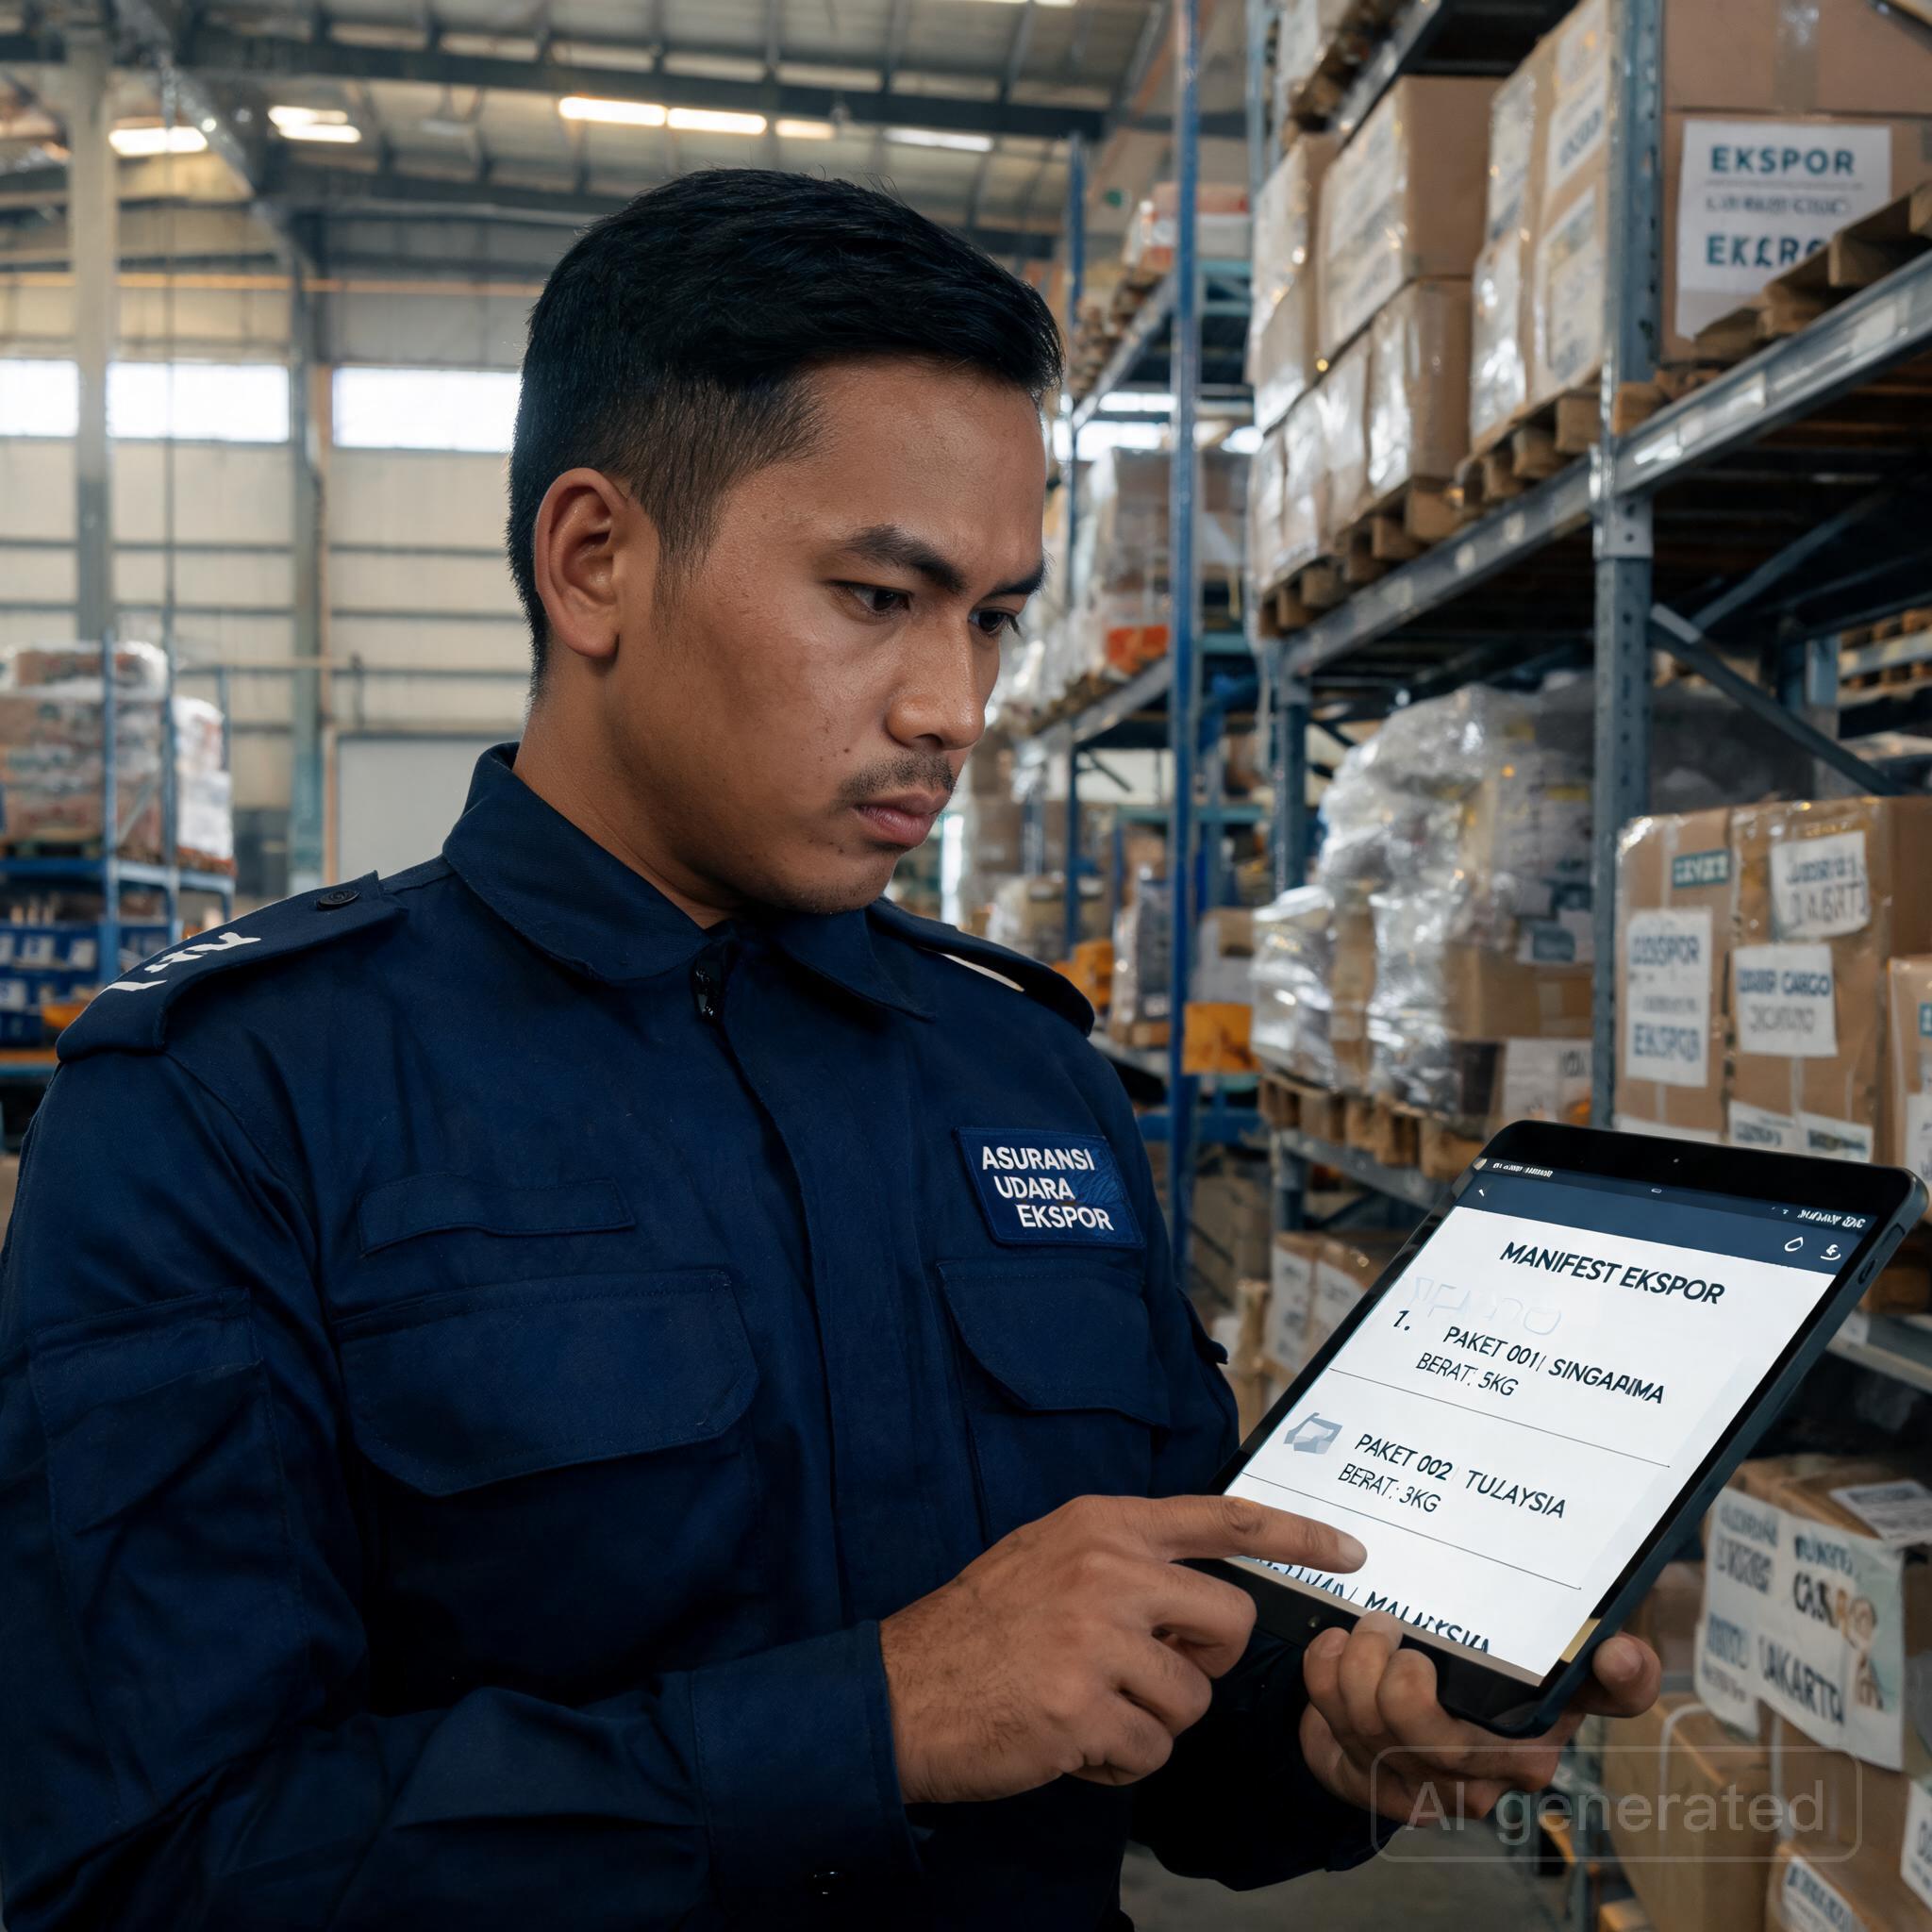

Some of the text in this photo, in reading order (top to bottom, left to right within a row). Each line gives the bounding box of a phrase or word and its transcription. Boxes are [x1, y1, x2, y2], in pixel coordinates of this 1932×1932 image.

[1710, 146, 1855, 175] EKSPOR
[982, 1145, 1095, 1171] ASURANSI
[993, 1175, 1076, 1201] UDARA
[1015, 1204, 1115, 1231] EKSPOR
[1499, 1241, 1725, 1305] MANIFEST EKSPOR
[1442, 1325, 1508, 1357] PAKET
[1477, 1371, 1519, 1396] 5KG
[1354, 1433, 1566, 1519] PAKET 002 TULAYSIA
[1399, 1486, 1442, 1513] 3KG
